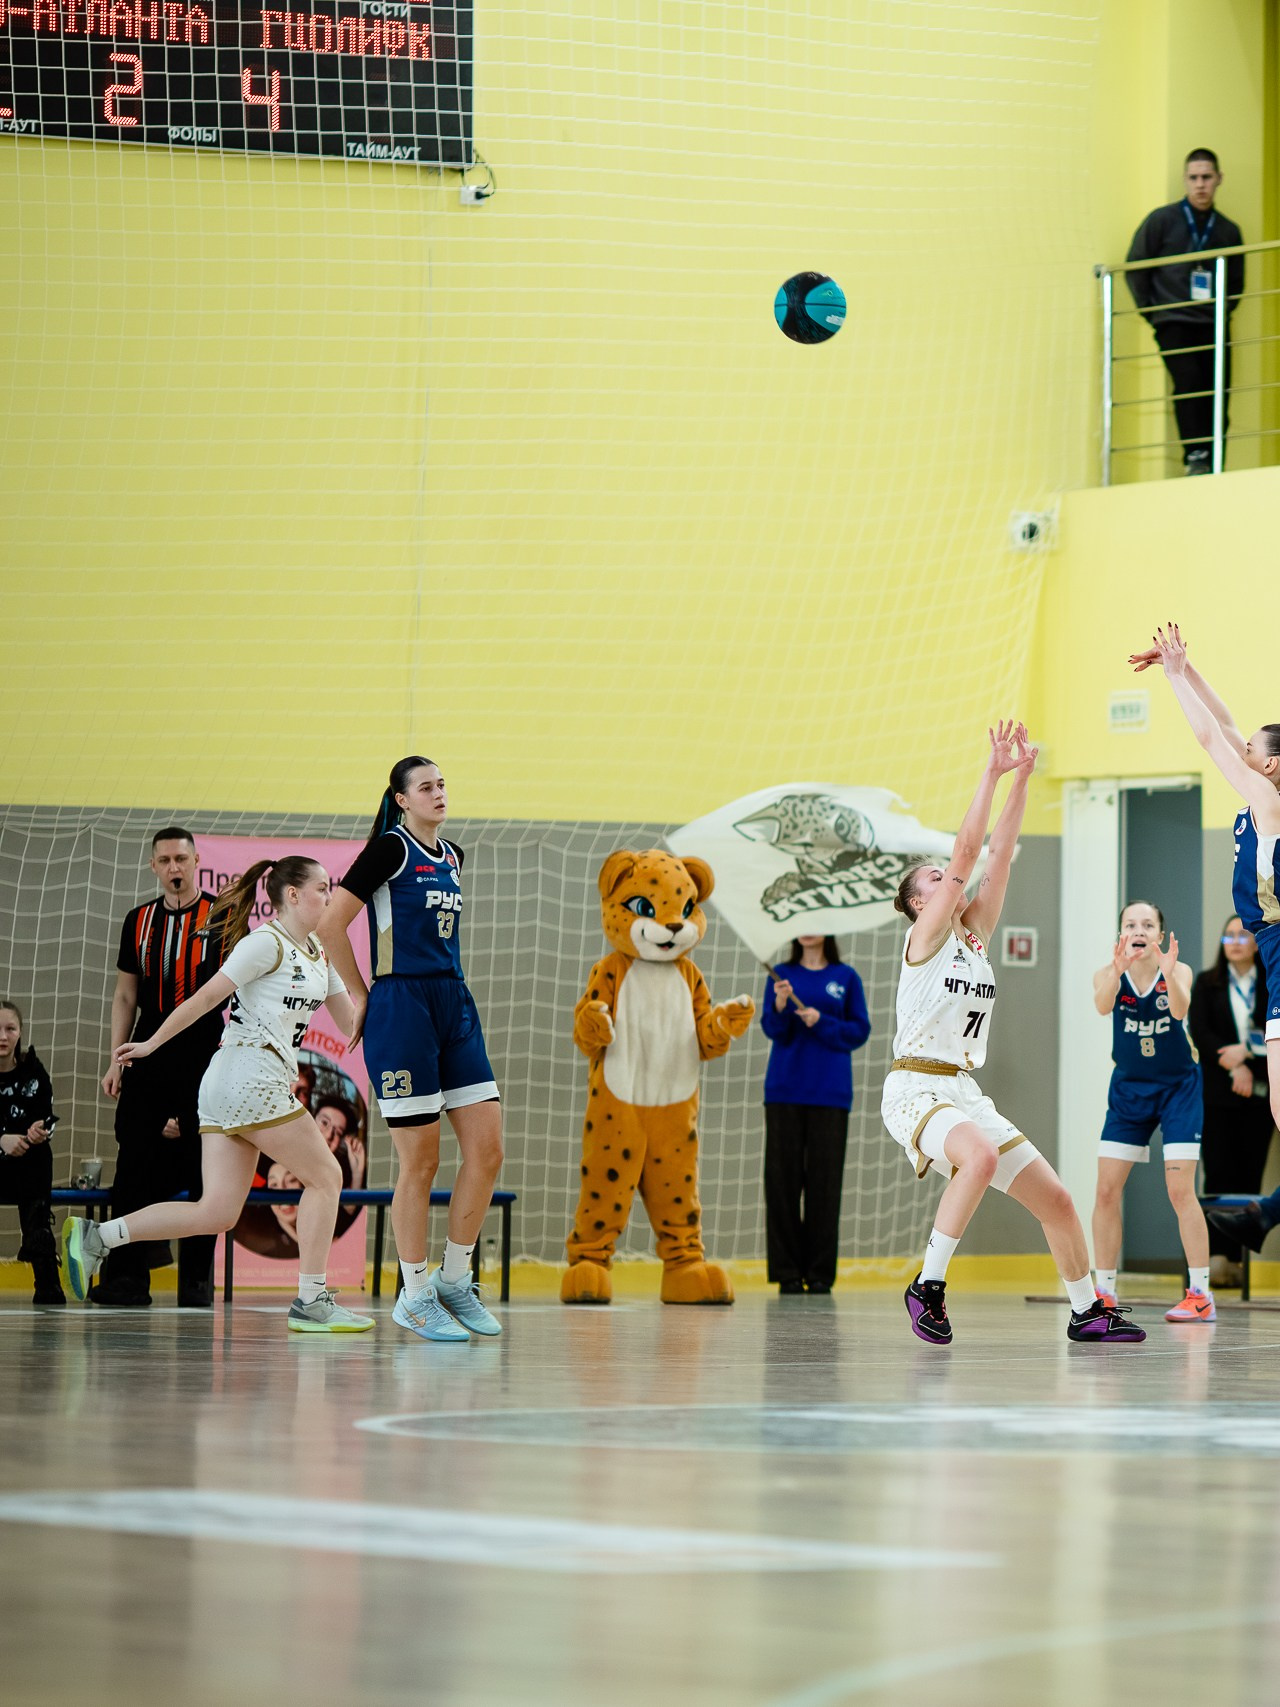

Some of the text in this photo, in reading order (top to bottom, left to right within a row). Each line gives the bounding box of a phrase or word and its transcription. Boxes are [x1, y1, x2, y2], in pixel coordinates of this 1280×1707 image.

[361, 1, 411, 17] ГОСТИ
[0, 0, 208, 43] -АТЛАНТА
[104, 53, 143, 125] 2
[243, 67, 280, 131] 4
[0, 118, 38, 133] -АУТ
[168, 126, 216, 143] ФОЛЫ
[346, 141, 421, 160] ТАЙМ-АУТ
[425, 890, 462, 911] РУС
[437, 911, 454, 939] 23
[963, 1010, 986, 1039] 71
[1140, 1037, 1155, 1057] 8
[381, 1070, 412, 1098] 23
